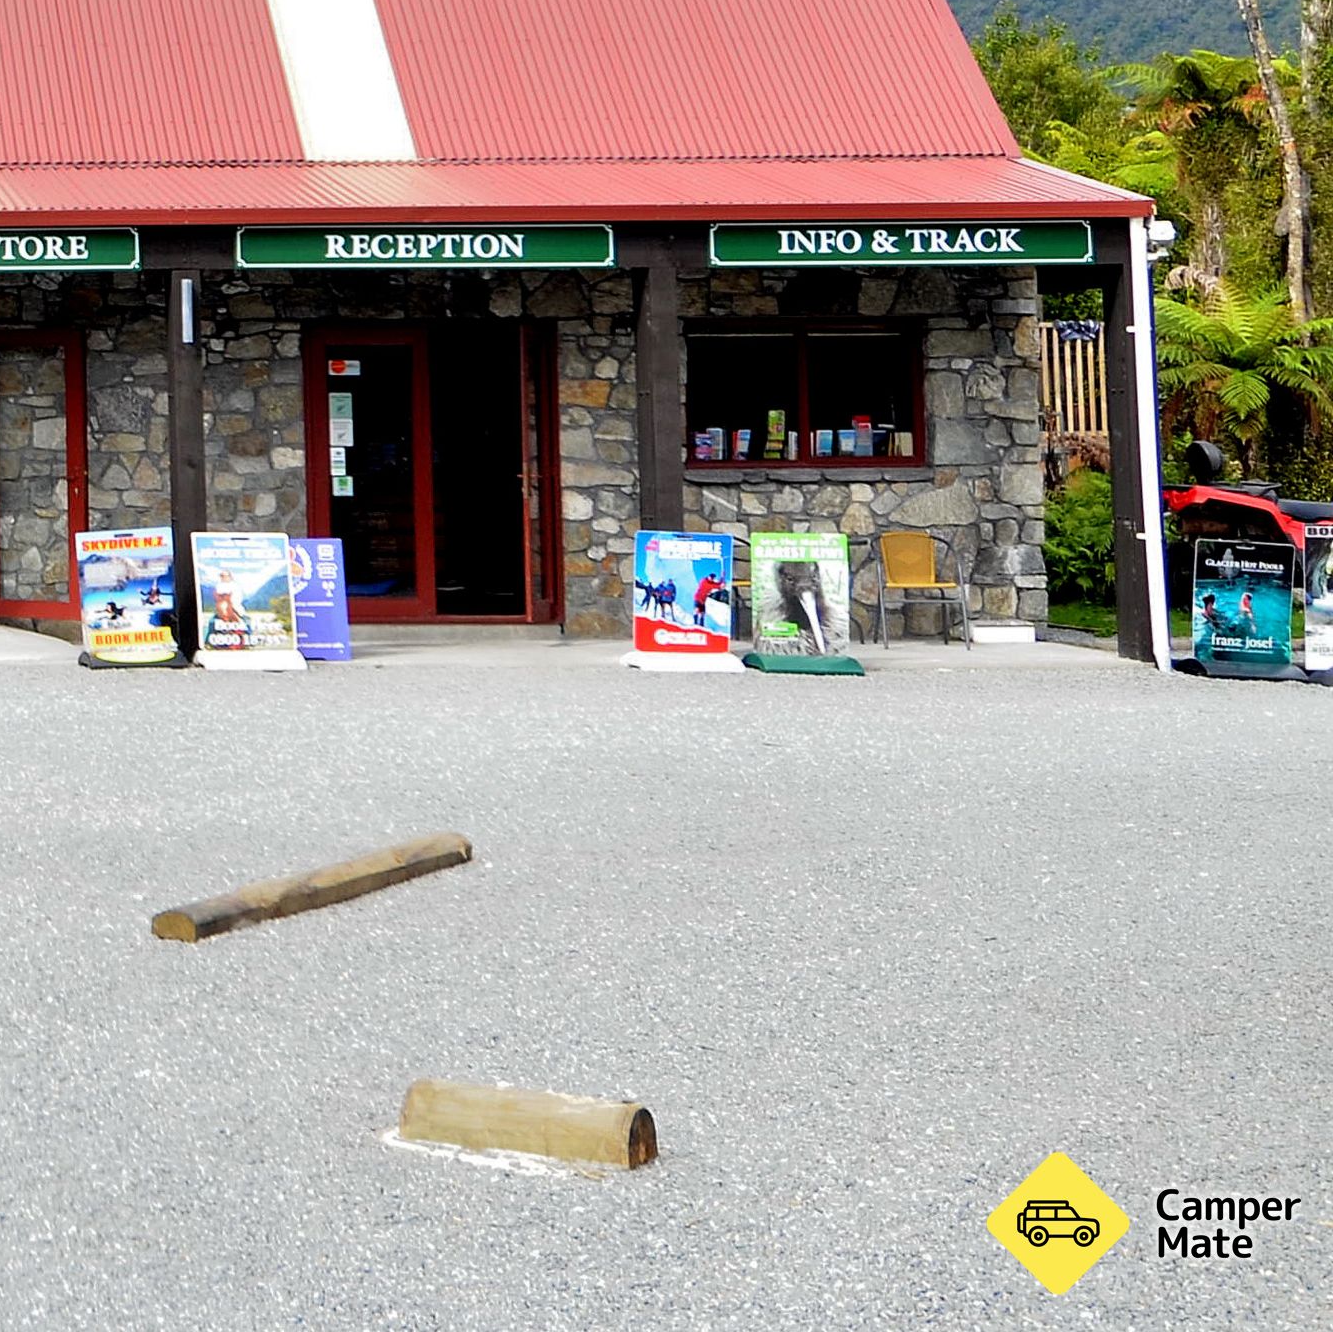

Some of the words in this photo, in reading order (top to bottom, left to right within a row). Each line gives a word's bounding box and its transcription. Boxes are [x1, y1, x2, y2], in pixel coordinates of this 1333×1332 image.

[325, 234, 525, 259] RECEPTION
[778, 229, 862, 254] INFO
[871, 229, 900, 254] &
[905, 228, 1024, 253] TRACK
[1307, 527, 1333, 536] BO
[82, 538, 139, 552] SKYDIVE
[144, 536, 167, 547] N.Z.
[95, 634, 130, 645] BOOK
[134, 631, 165, 643] HERE
[1211, 632, 1243, 647] franz
[1245, 636, 1273, 649] josef
